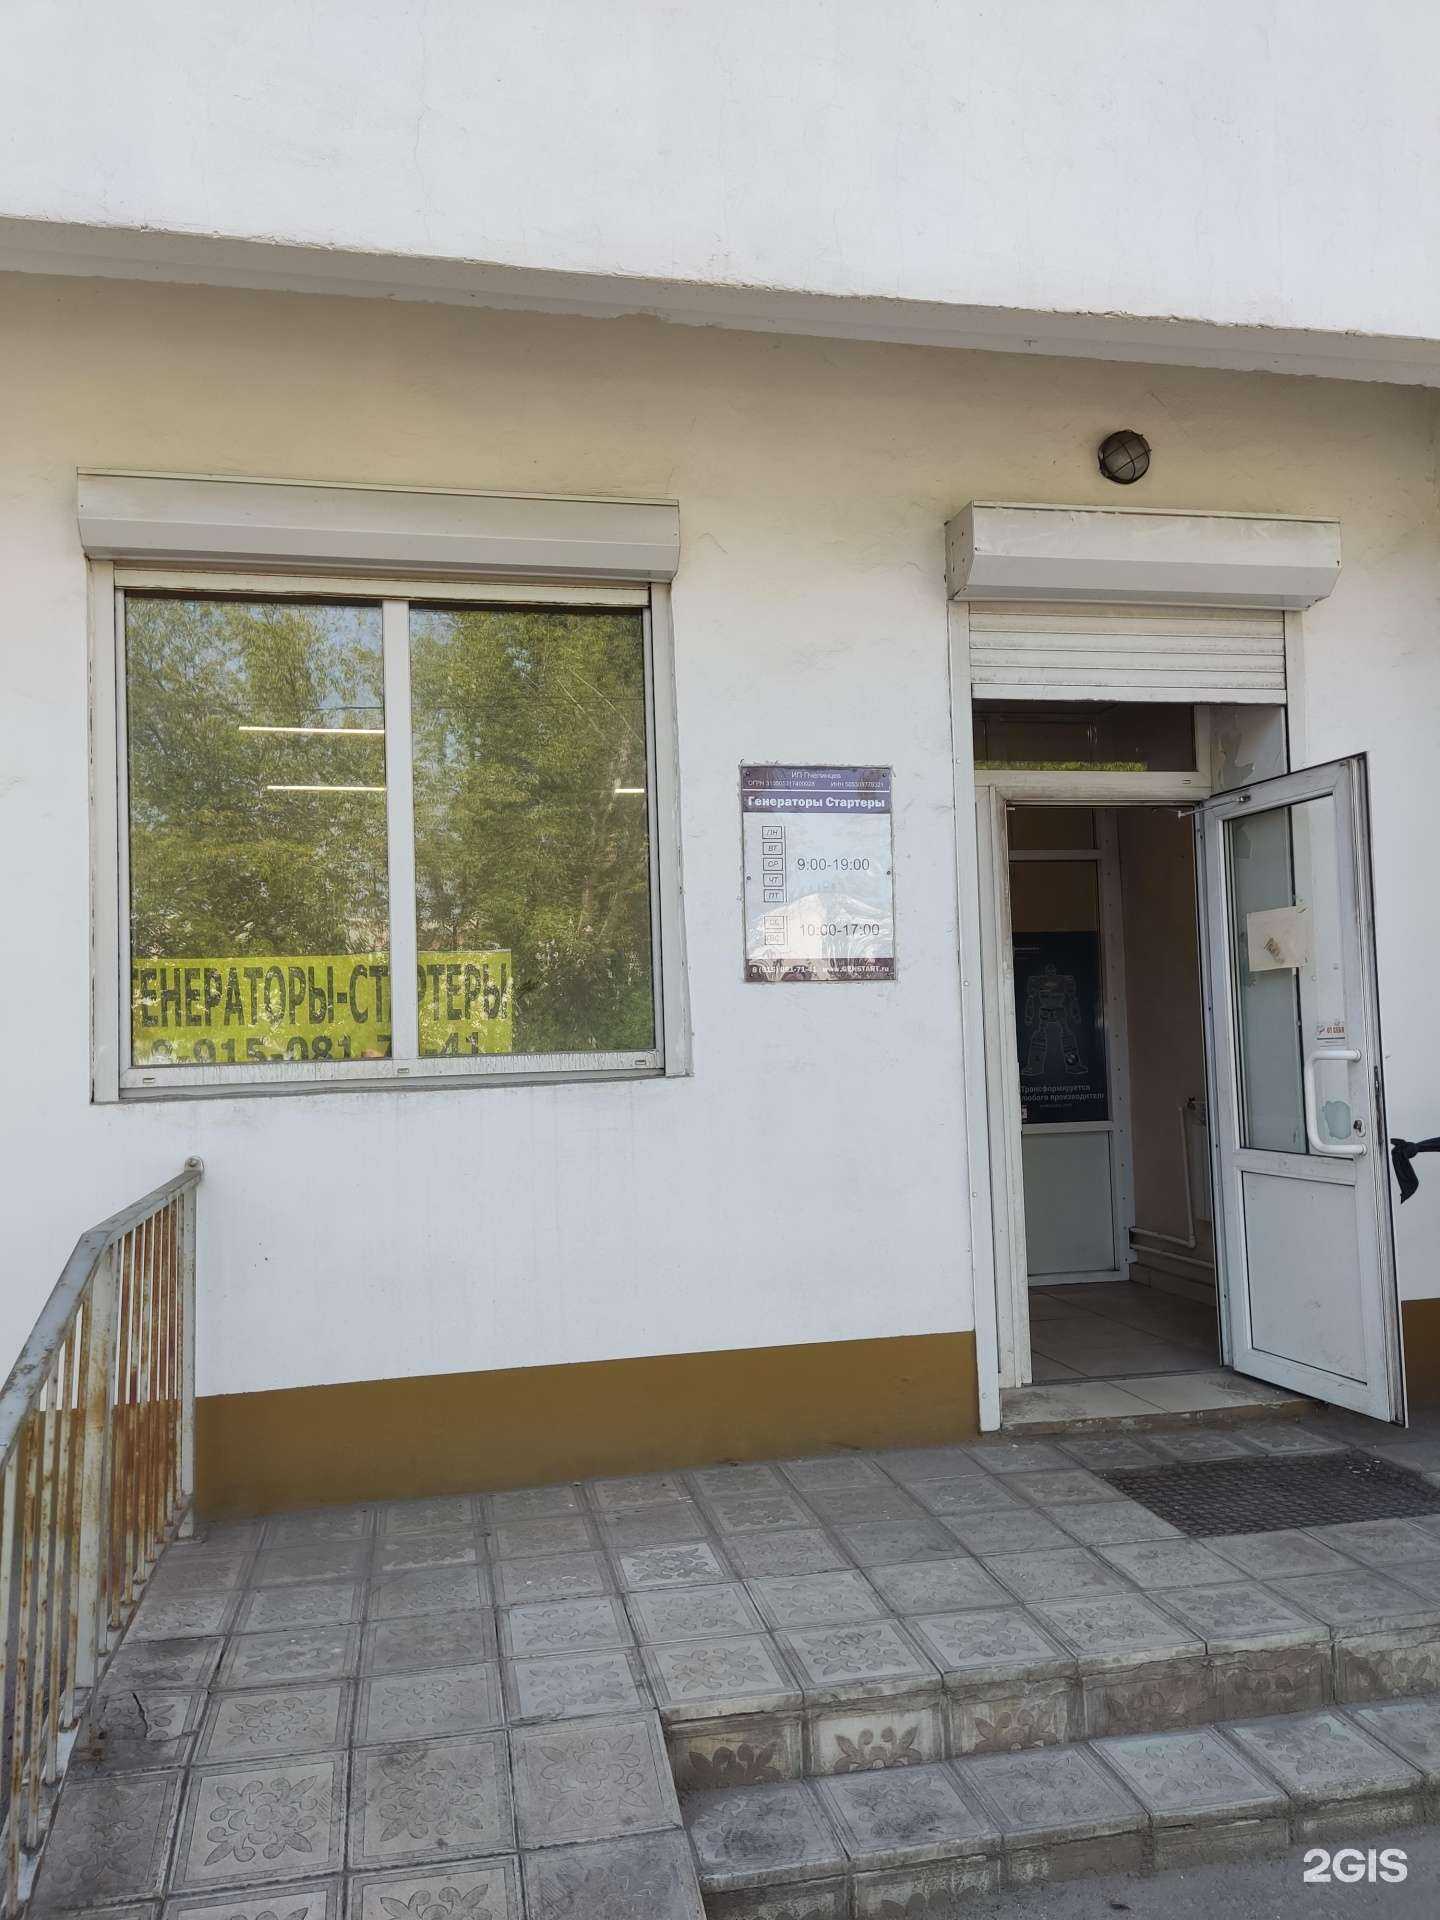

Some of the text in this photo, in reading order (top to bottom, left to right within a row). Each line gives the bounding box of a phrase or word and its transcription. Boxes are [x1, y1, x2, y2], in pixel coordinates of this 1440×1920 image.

[748, 796, 885, 809] Генераторы Стартеры
[767, 860, 779, 868] СР
[797, 858, 870, 871] 9:00-19:00
[768, 876, 780, 884] ЧТ
[799, 923, 880, 937] 10:00-17:00
